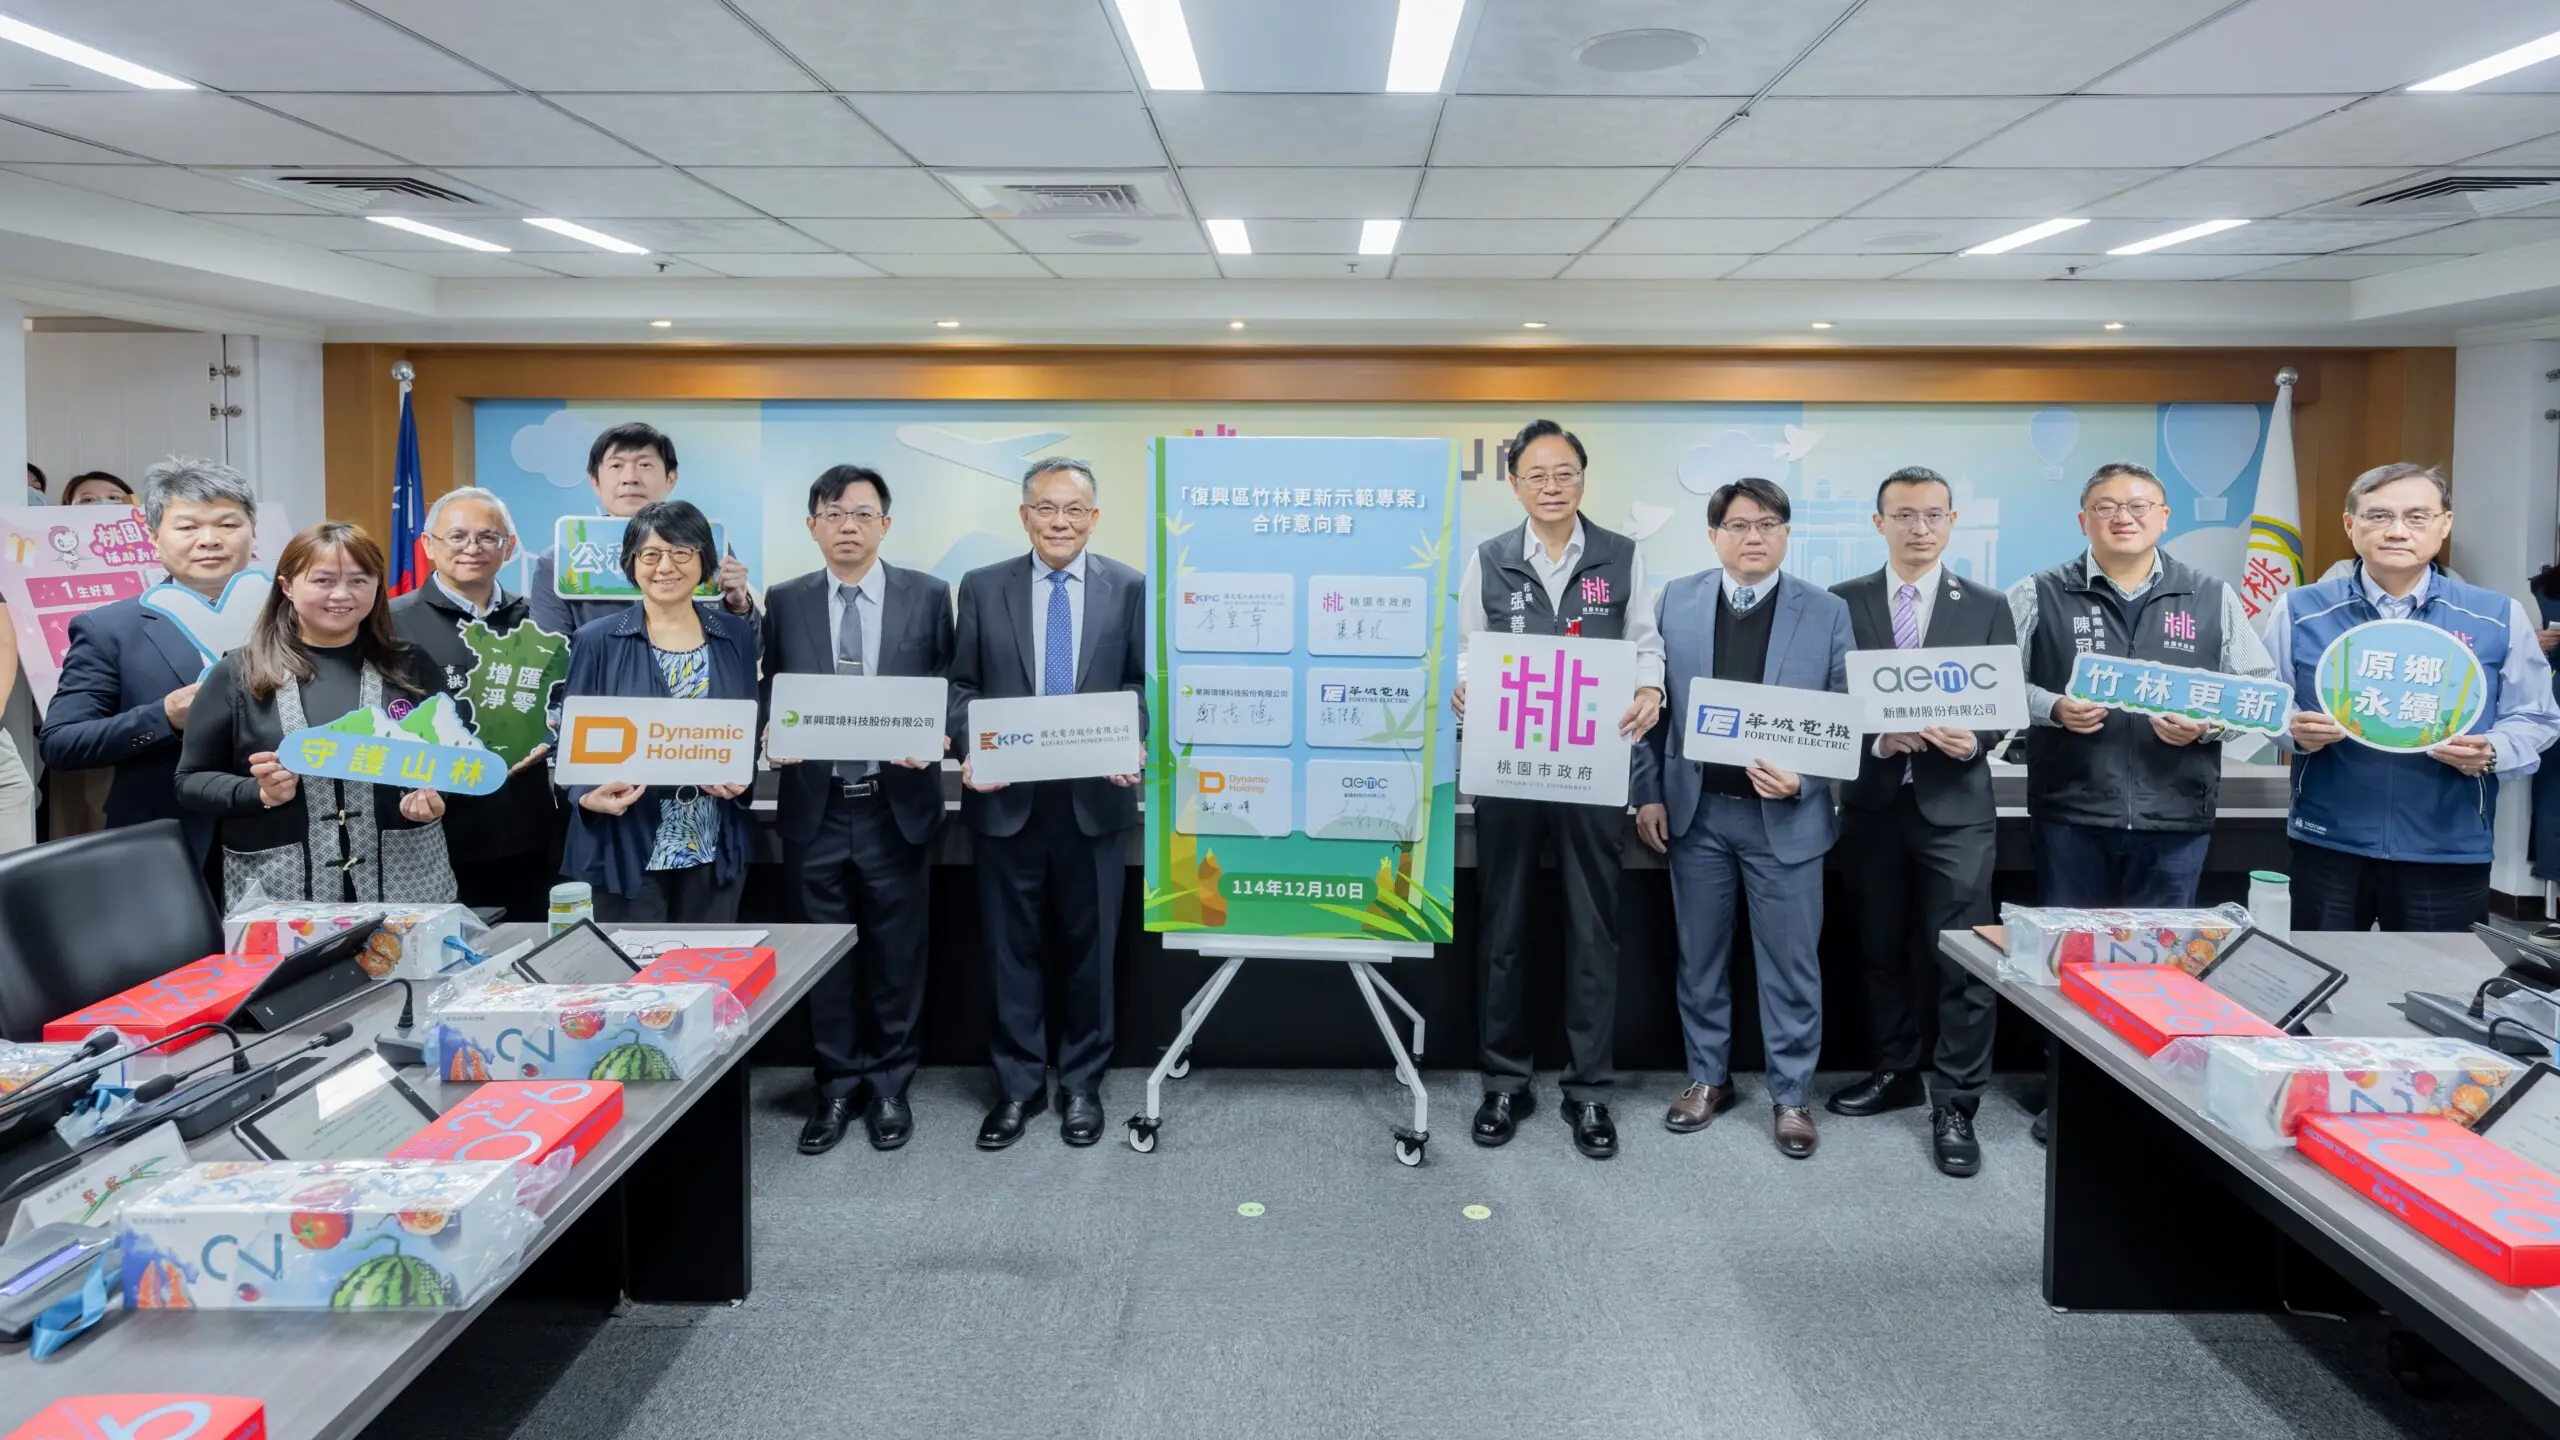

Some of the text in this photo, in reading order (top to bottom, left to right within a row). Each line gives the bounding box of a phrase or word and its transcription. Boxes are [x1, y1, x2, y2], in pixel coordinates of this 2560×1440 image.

[1180, 486, 1428, 509] 「復興區竹林更新示範專案」
[96, 521, 151, 548] 桃園
[1252, 514, 1353, 534] 合作意向書
[1196, 594, 1220, 603] KPC
[1350, 597, 1412, 608] 桃園市政府
[486, 662, 543, 689] 增匯
[1872, 661, 1998, 694] aemc
[2357, 650, 2445, 687] 原鄉
[480, 686, 537, 714] 淨零
[2086, 662, 2278, 723] 竹林更新
[1883, 704, 1997, 720] 新應材股份有限公司
[2354, 687, 2440, 724] 永續
[648, 721, 744, 742] Dynamic
[802, 714, 934, 728] 業興環境科技股份有限公司
[1745, 711, 1851, 740] 華城電機
[998, 732, 1034, 746] KPC
[1744, 730, 1850, 751] FORTUNE ELECTRIC
[301, 738, 485, 788] 守護山林
[646, 742, 731, 764] Holding
[1229, 774, 1270, 784] Dynamic
[1496, 760, 1593, 780] 桃園市政府
[1229, 784, 1265, 793] Holding
[1231, 878, 1365, 900] 114年12月10日
